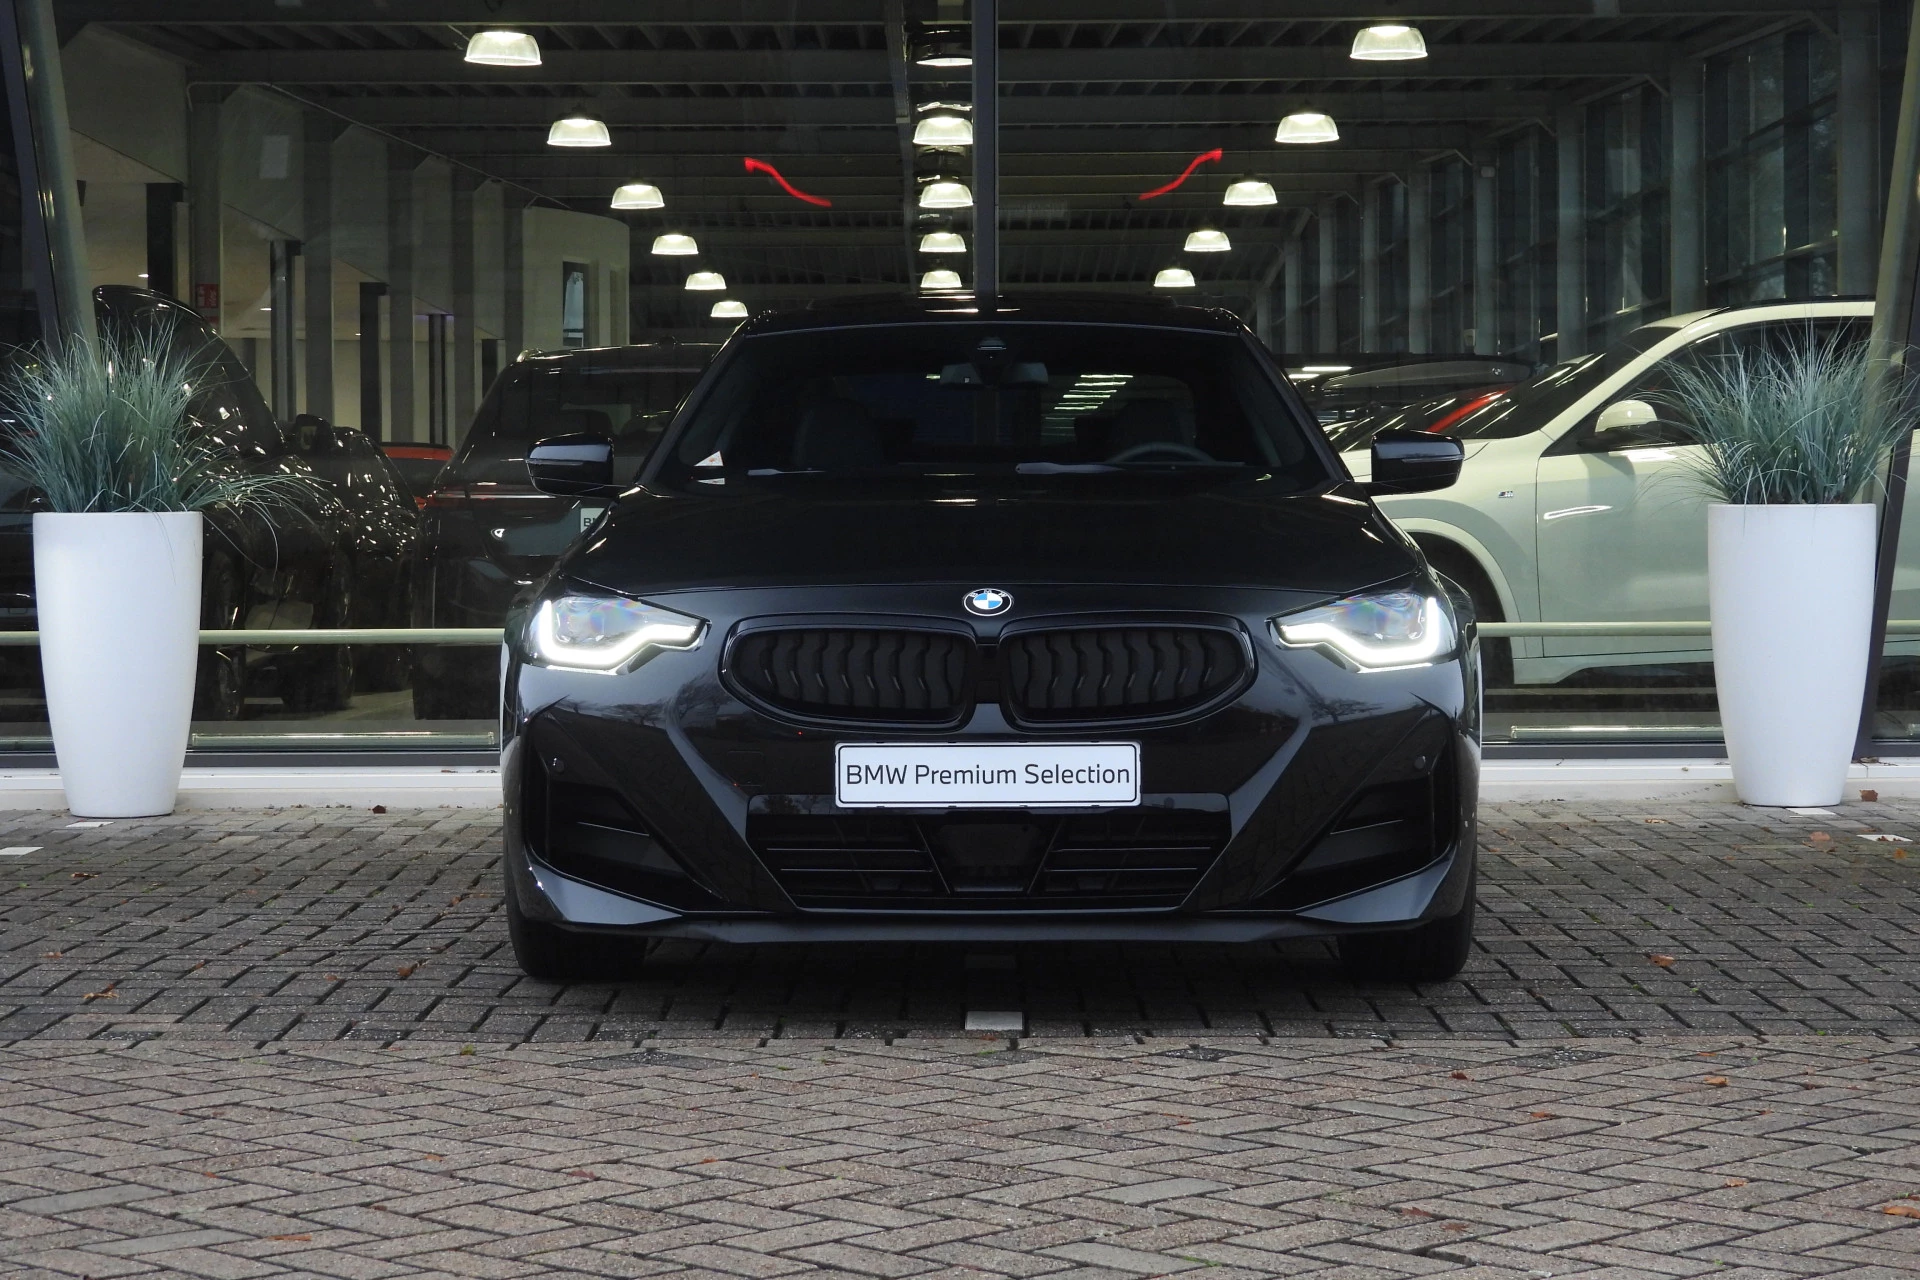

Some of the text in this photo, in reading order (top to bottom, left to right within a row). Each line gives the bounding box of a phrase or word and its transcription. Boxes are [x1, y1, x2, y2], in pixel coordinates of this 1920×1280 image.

[846, 763, 1131, 785] BMW Premium Selection
